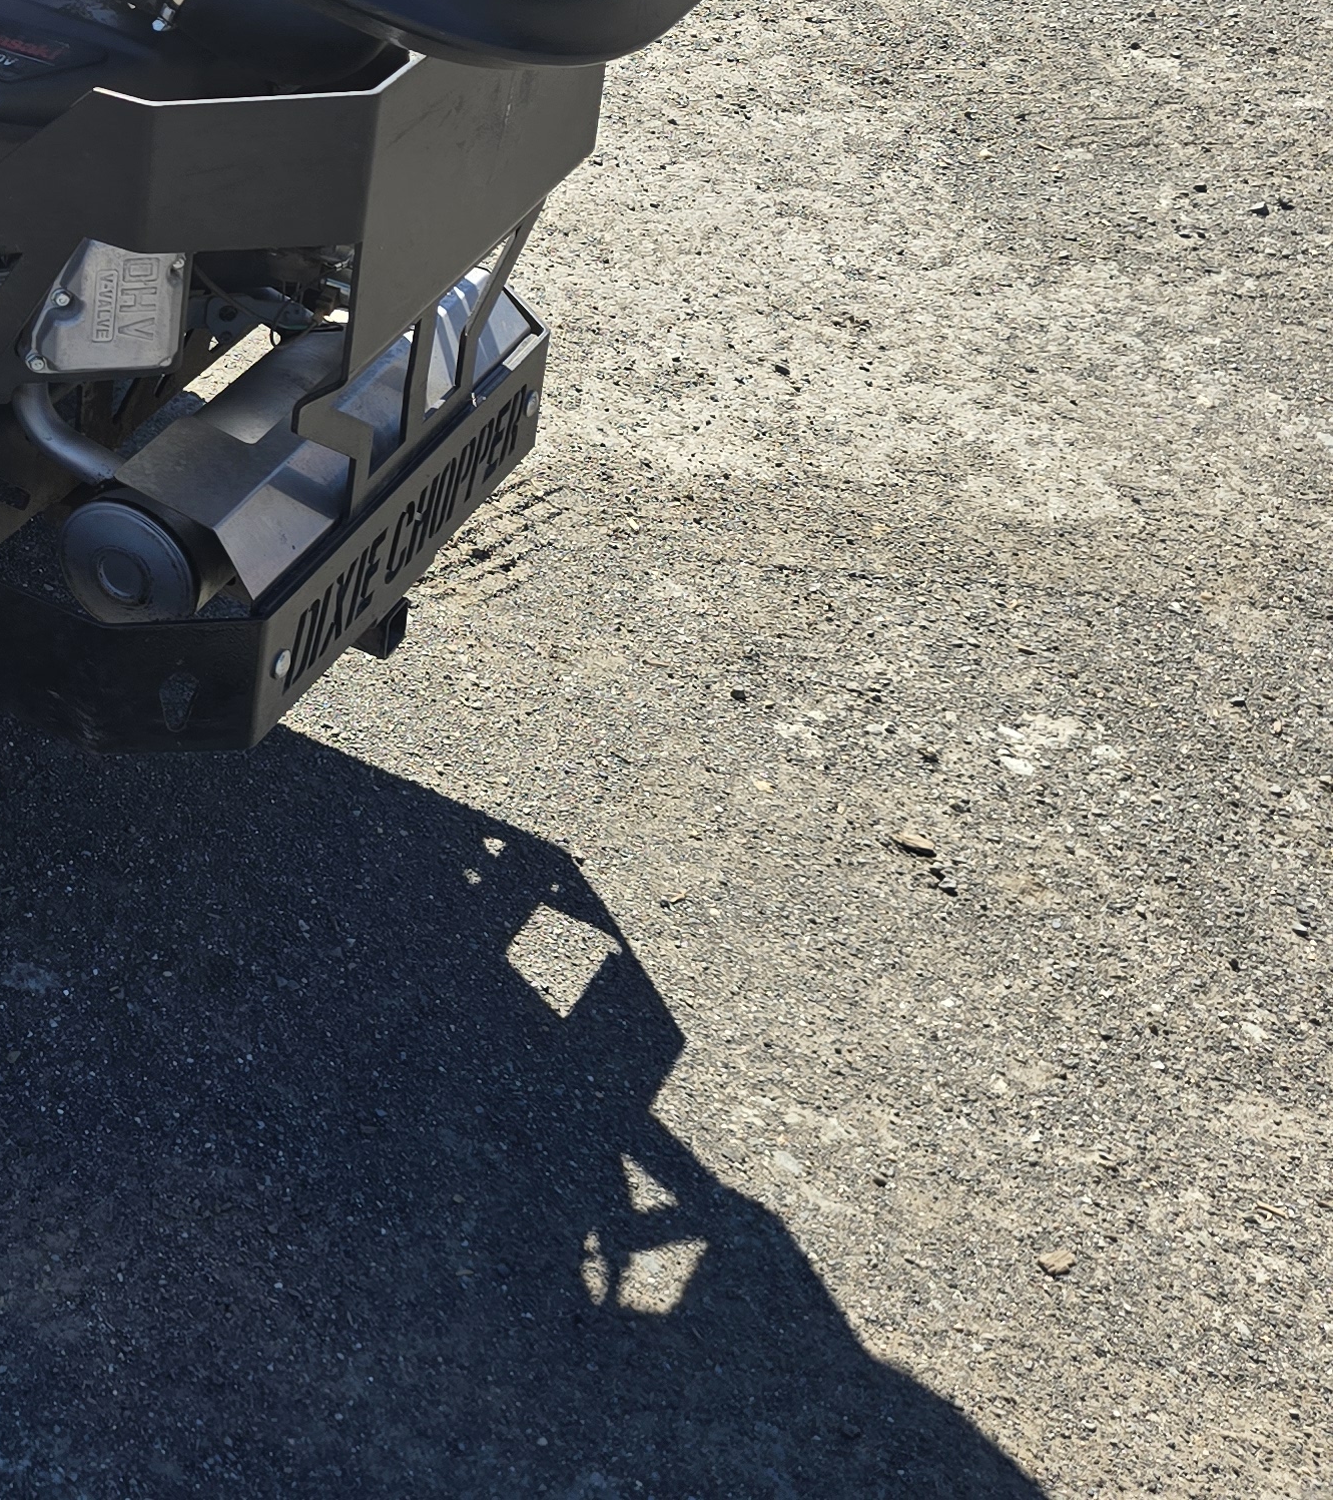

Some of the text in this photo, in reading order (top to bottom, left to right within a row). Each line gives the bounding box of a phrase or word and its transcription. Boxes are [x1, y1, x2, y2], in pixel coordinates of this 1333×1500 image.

[95, 272, 114, 340] V-VALVE
[118, 256, 161, 341] OHV
[284, 384, 528, 693] DIXIE CHOPPER
